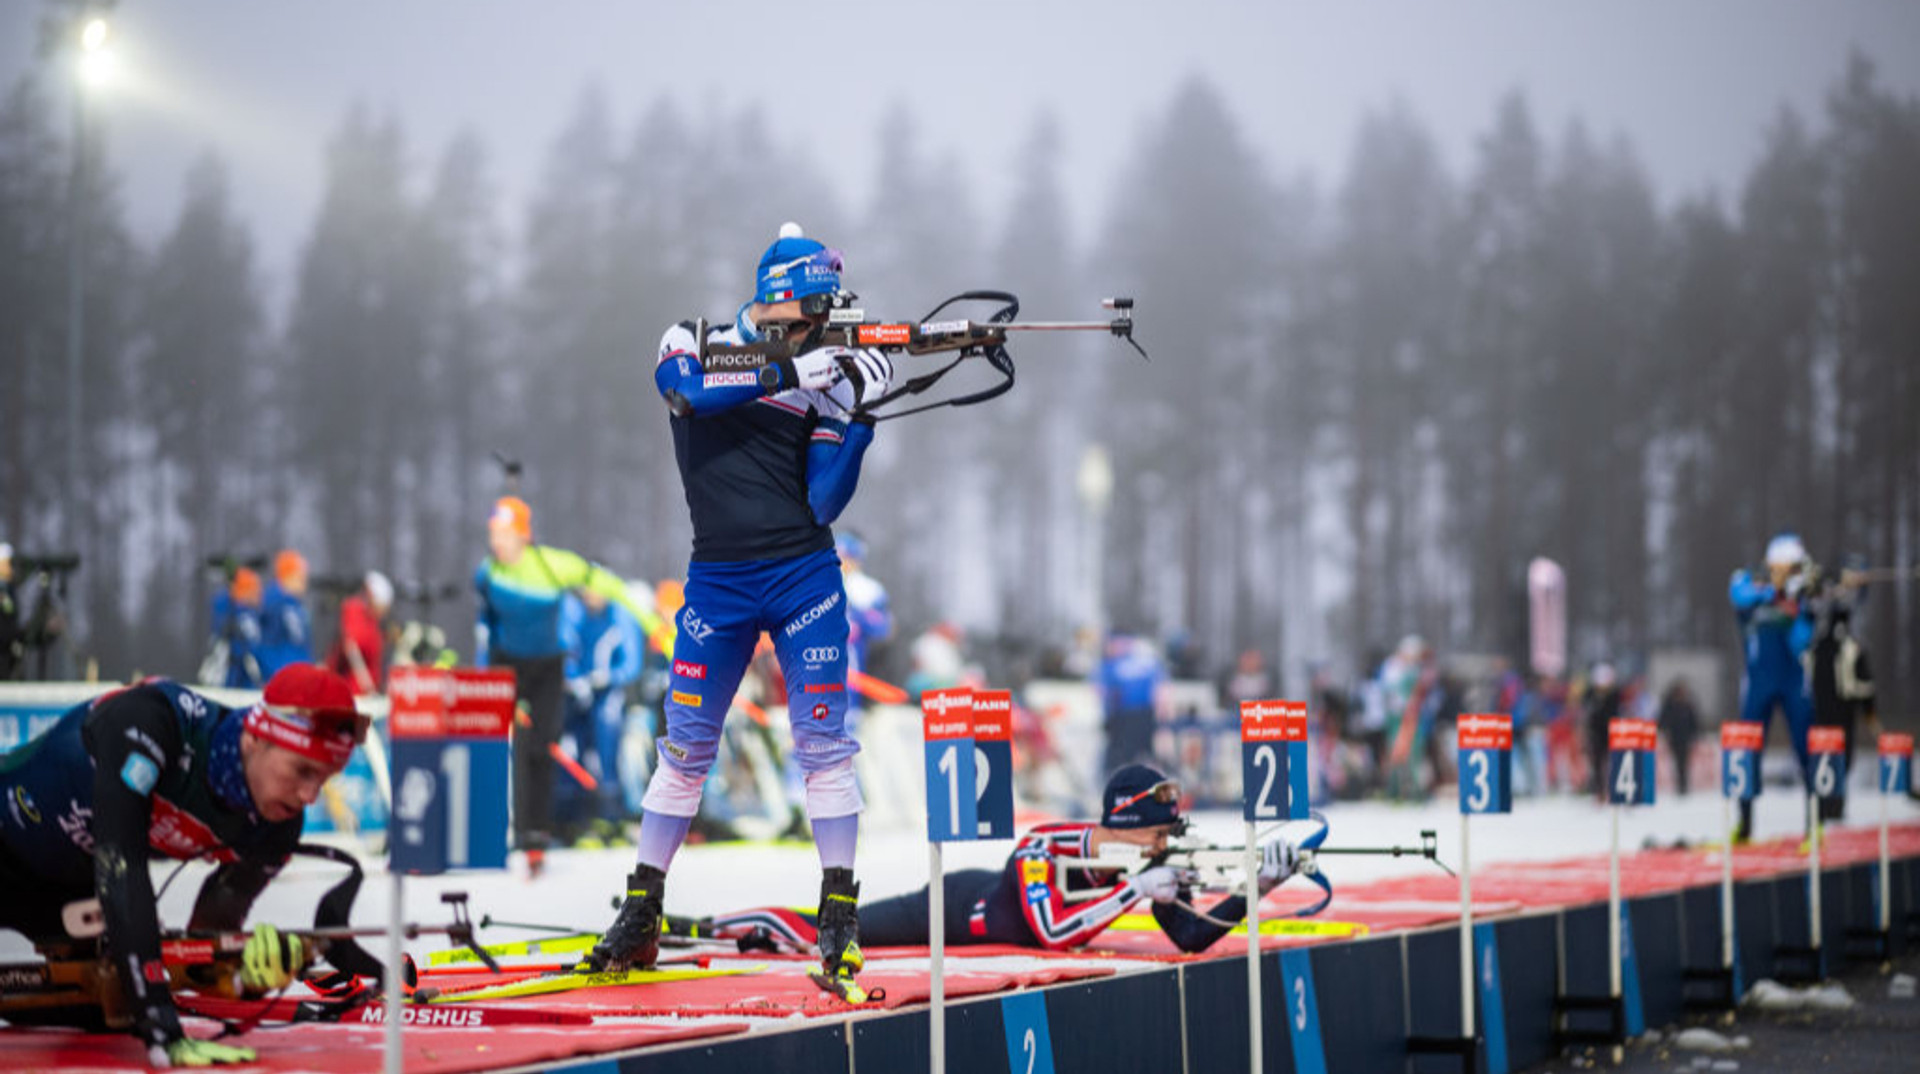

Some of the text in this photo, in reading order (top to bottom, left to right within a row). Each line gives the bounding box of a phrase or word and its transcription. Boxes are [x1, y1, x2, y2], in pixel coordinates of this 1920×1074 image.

[704, 372, 756, 386] FIOCCHI
[712, 353, 767, 367] FIOCCHI
[683, 606, 715, 638] EA7
[938, 745, 960, 836] 1
[1254, 744, 1277, 818] 2
[1467, 750, 1490, 812] 3
[1616, 750, 1637, 803] 4
[1728, 750, 1747, 799] 5
[1814, 752, 1835, 797] 6
[1886, 754, 1899, 793] 7
[440, 743, 470, 866] 1
[1295, 975, 1307, 1032] 3
